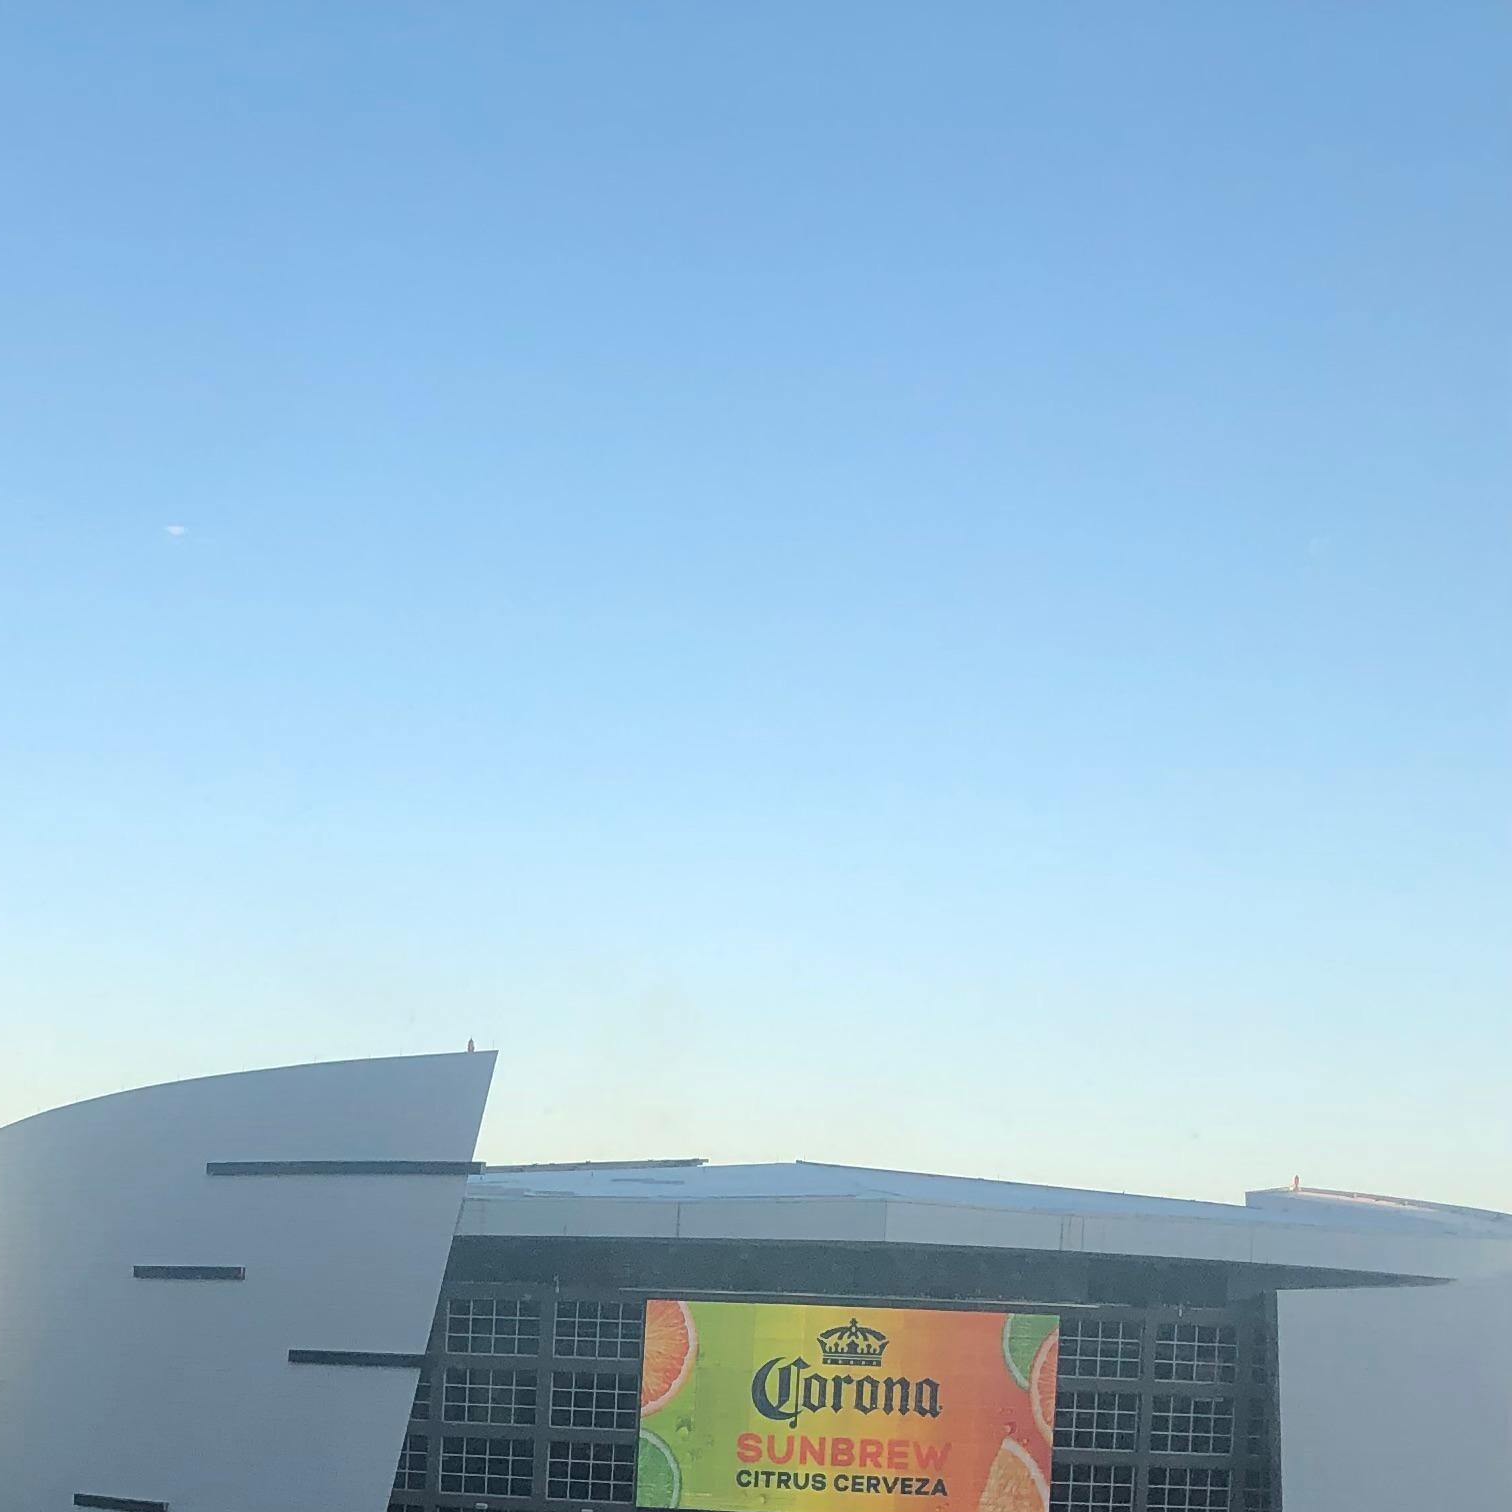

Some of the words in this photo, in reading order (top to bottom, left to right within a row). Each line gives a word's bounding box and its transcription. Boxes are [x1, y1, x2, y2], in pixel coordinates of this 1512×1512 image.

[752, 1356, 942, 1428] Corona
[736, 1432, 952, 1471] SUNBREW
[736, 1469, 827, 1491] CITRUS
[833, 1473, 949, 1496] CERVEZA
